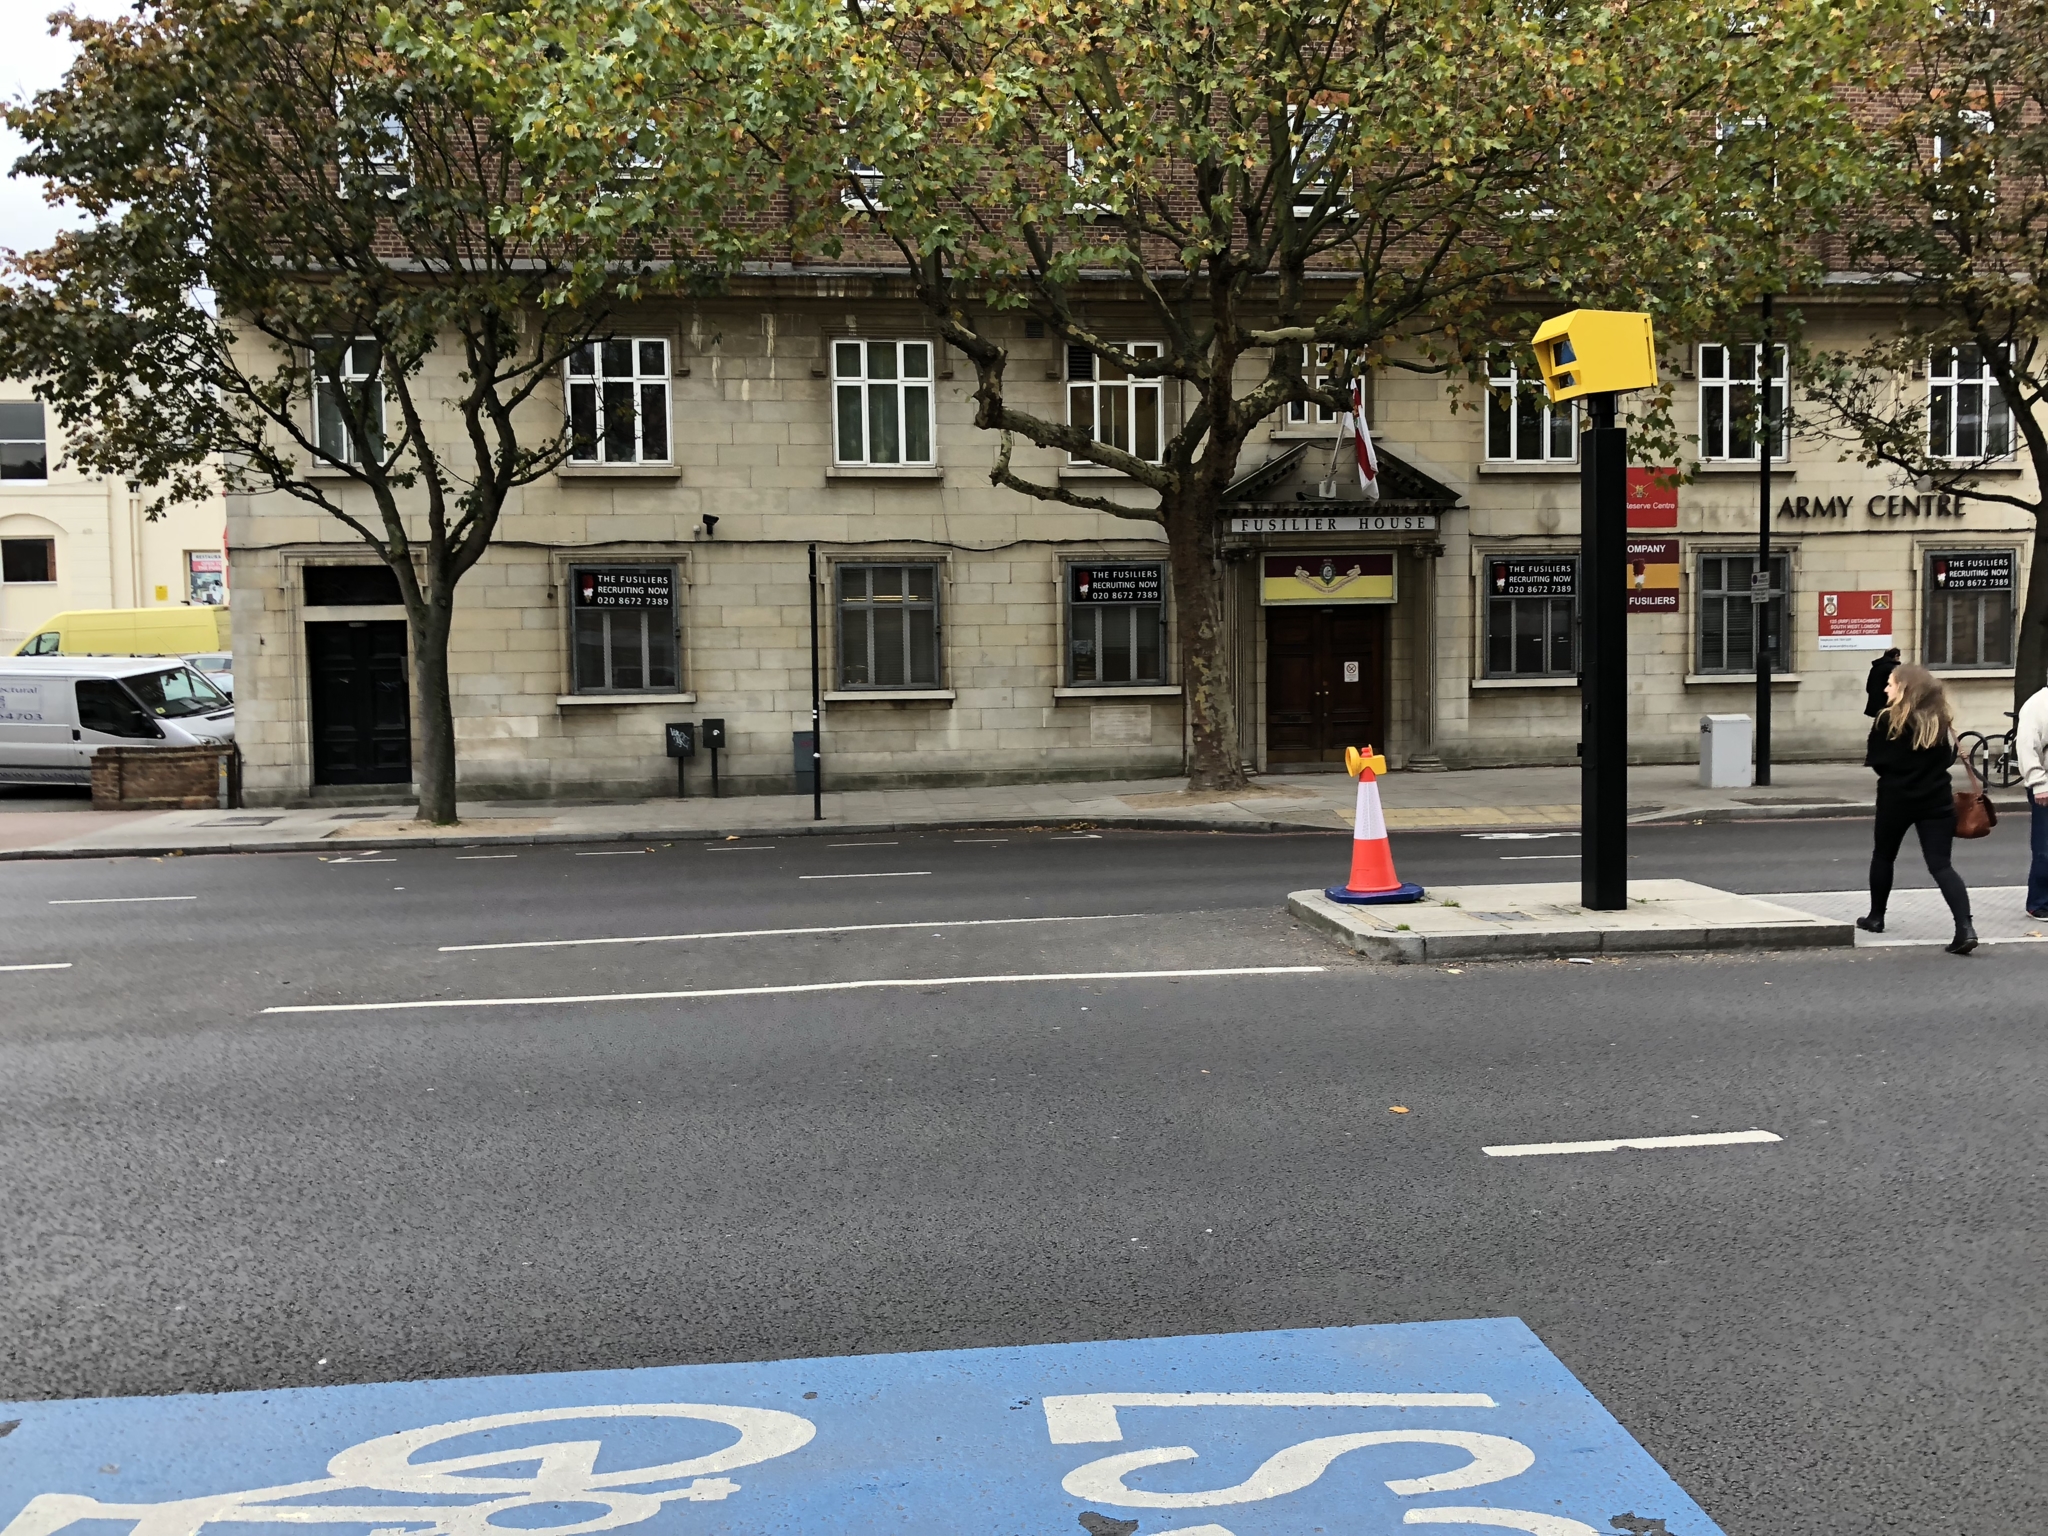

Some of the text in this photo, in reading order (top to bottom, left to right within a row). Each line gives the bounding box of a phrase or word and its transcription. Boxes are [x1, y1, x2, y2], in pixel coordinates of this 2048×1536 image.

[1652, 502, 1676, 510] Centre
[1777, 494, 1967, 518] ARMY CENTRE
[1241, 516, 1426, 531] FUSILIER HOUSE
[1627, 544, 1666, 553] OMPANY
[1113, 570, 1158, 578] FUSILIERS
[620, 576, 668, 584] FUSILIERS
[598, 586, 644, 594] RECRUITING
[598, 596, 615, 604] 020
[646, 598, 668, 606] 7389
[1629, 596, 1676, 606] FUSILIERS
